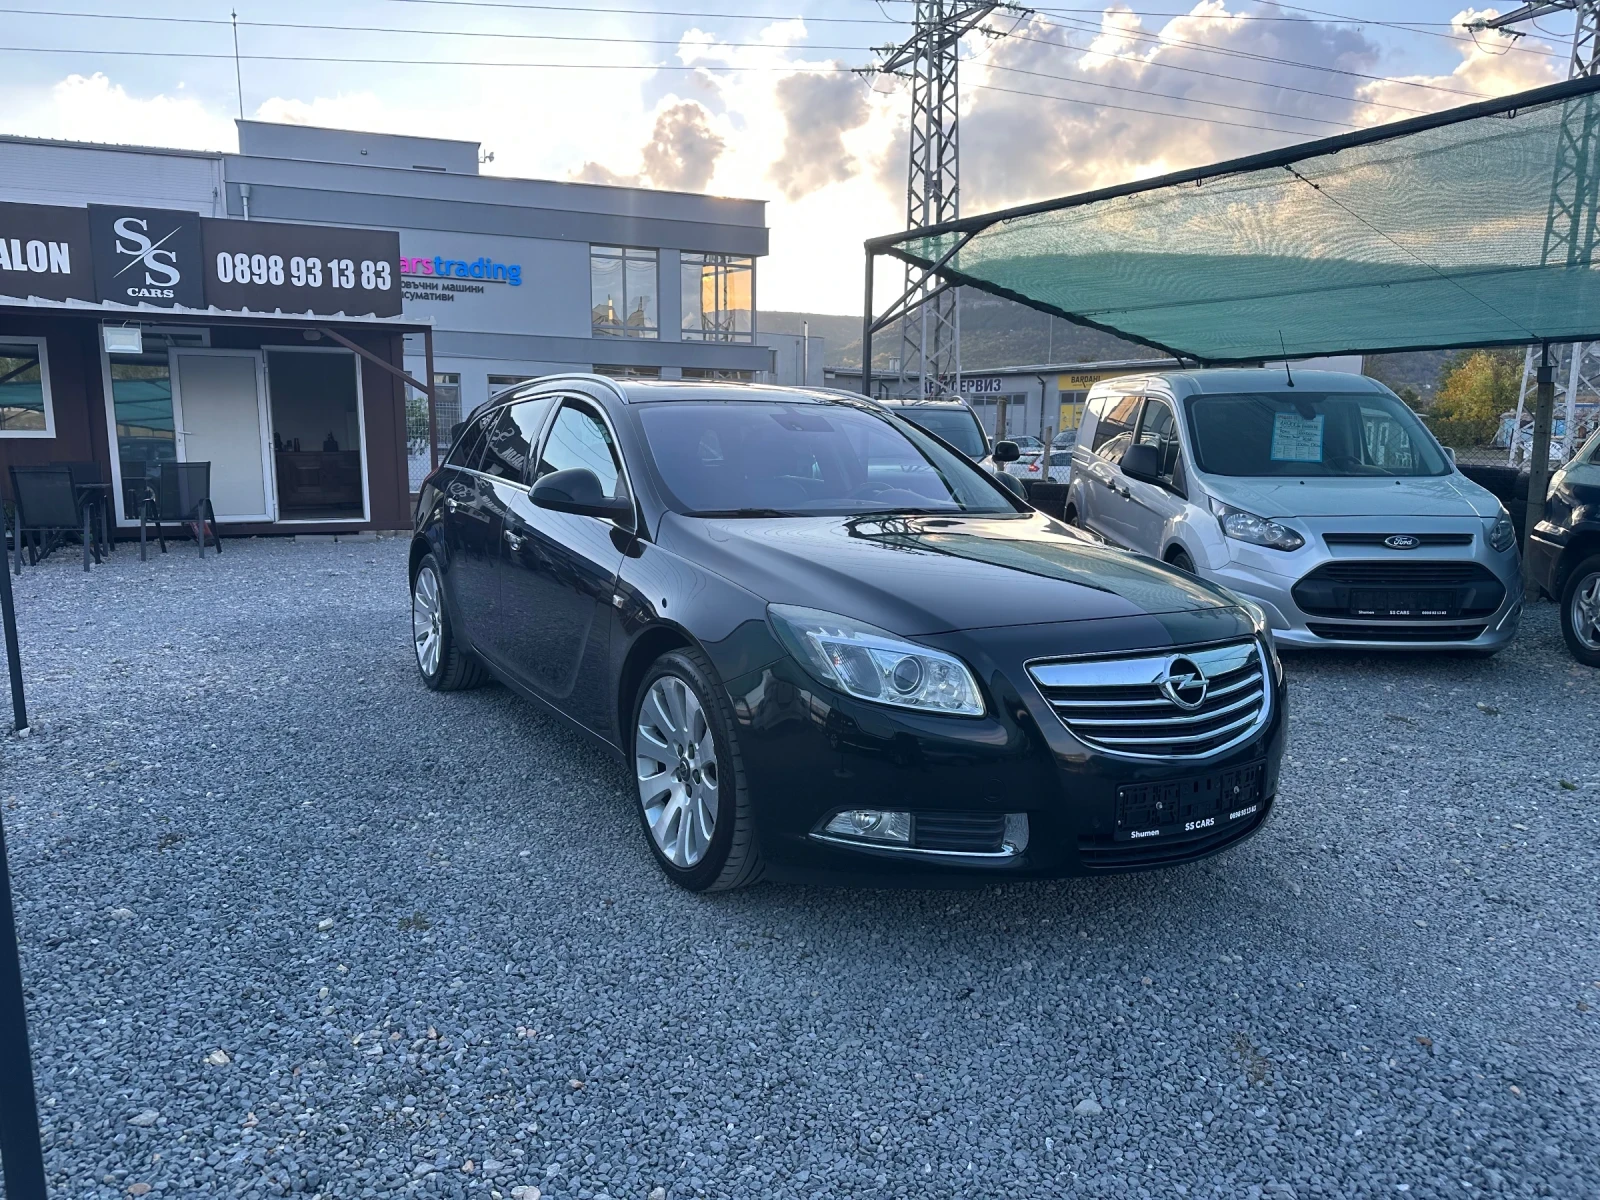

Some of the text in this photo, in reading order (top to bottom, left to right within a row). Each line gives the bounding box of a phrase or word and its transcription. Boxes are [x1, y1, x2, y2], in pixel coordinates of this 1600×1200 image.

[216, 251, 392, 291] 0898 93 13 83
[127, 287, 175, 298] CARS
[441, 283, 485, 294] машини
[1393, 537, 1413, 546] Ford
[1131, 829, 1160, 839] Shumen
[1185, 822, 1195, 831] SS
[1195, 817, 1215, 829] CARS
